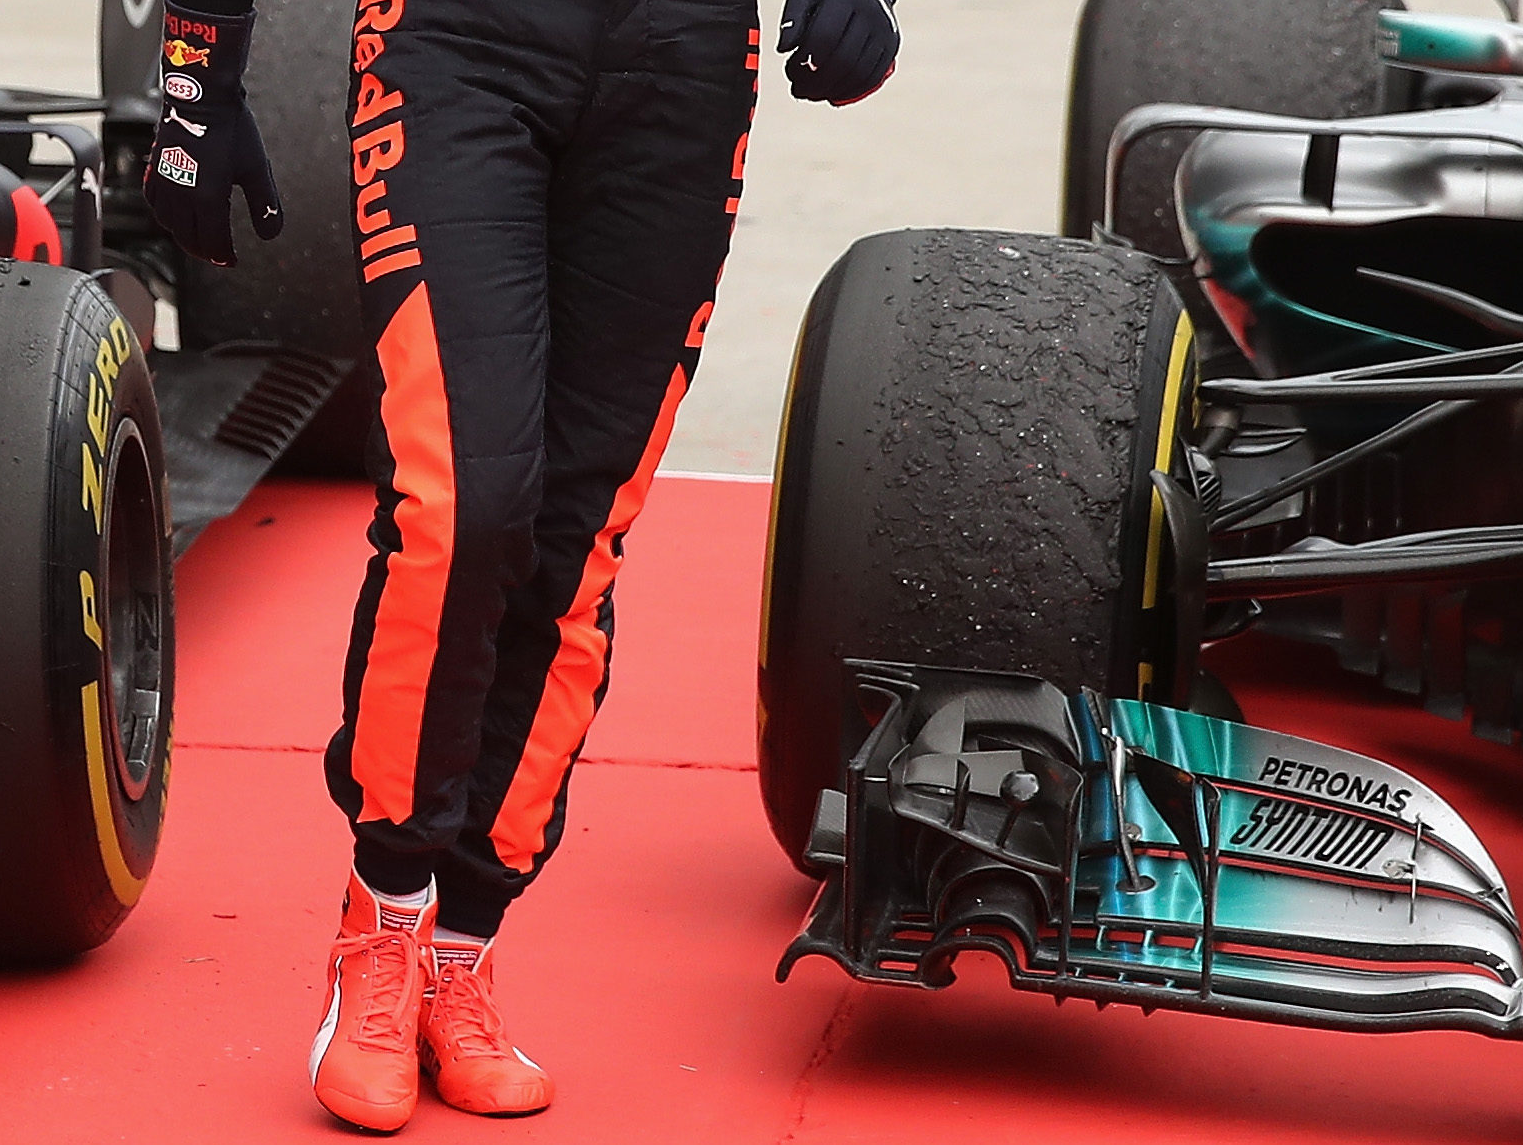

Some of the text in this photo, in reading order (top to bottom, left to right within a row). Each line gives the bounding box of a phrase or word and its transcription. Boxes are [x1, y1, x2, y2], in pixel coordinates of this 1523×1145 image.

[161, 161, 194, 185] TAG
[353, 120, 422, 284] Bull
[81, 315, 131, 535] ZERO
[1259, 757, 1413, 815] PETRONAS
